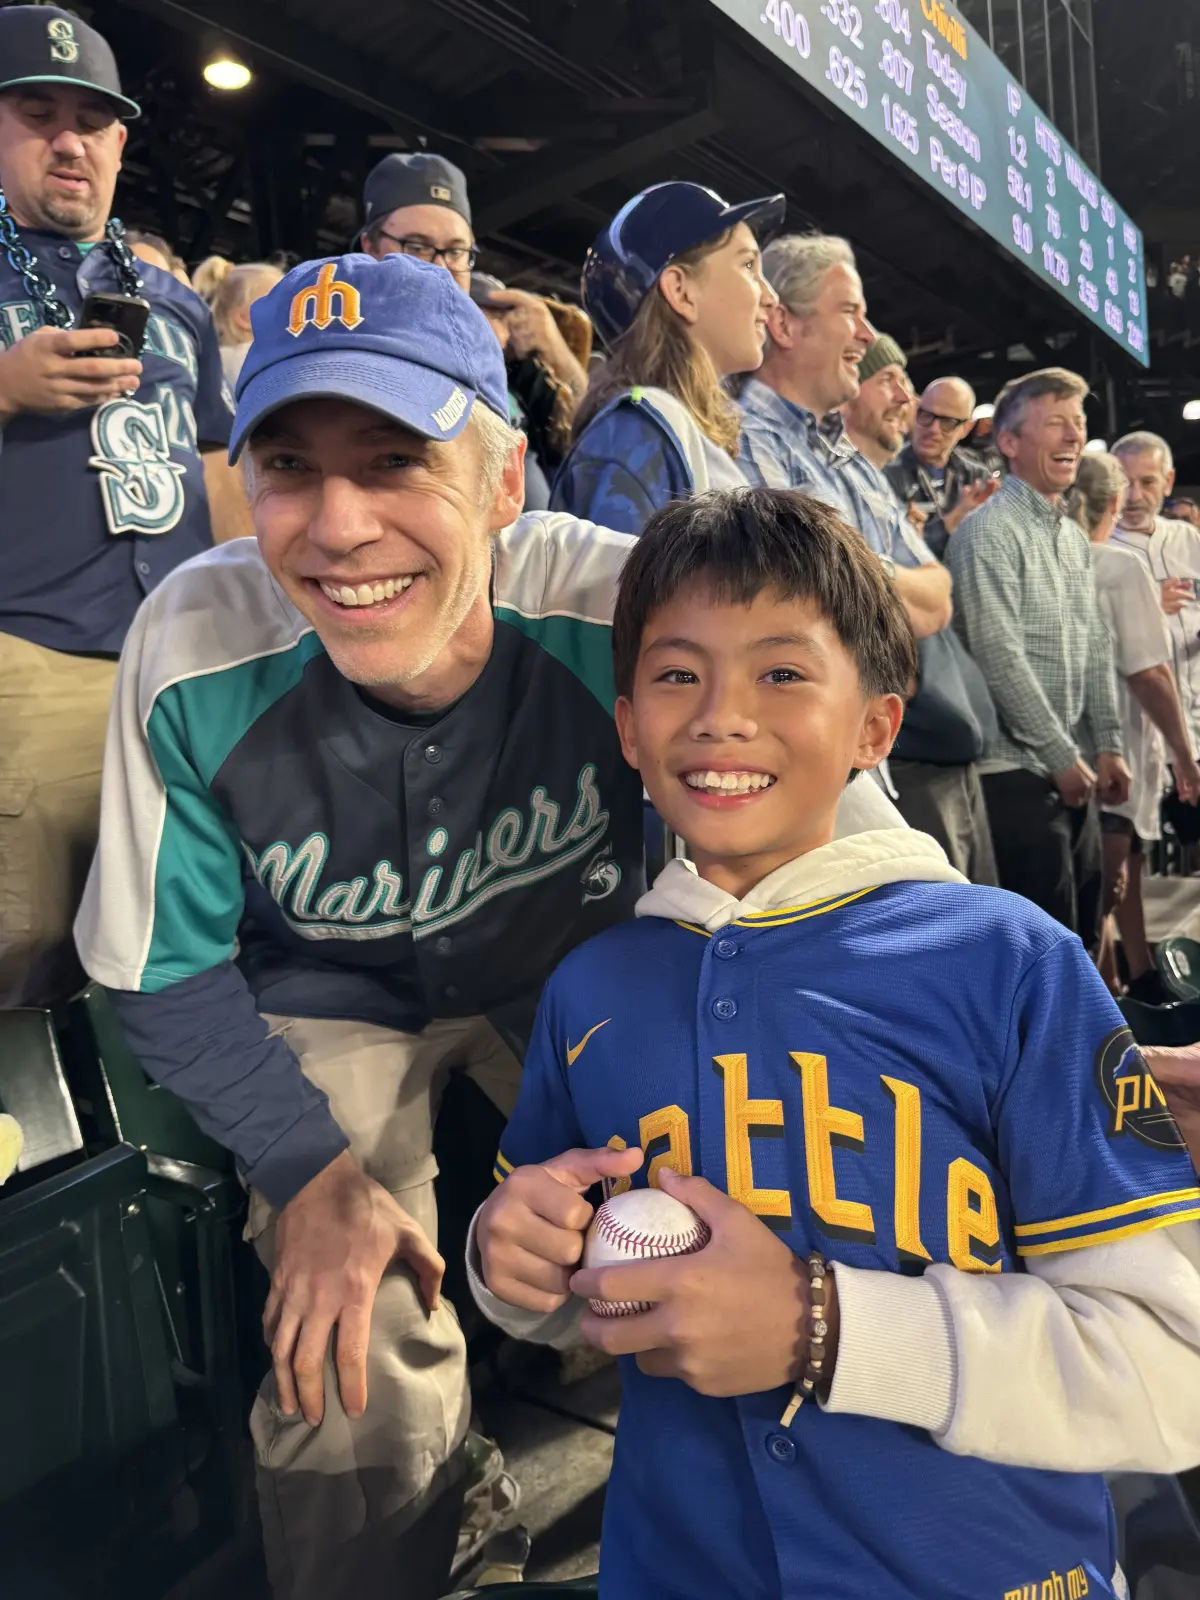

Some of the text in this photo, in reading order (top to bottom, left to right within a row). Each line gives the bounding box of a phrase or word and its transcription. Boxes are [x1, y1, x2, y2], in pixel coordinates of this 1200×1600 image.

[760, 0, 811, 59] .400
[825, 45, 868, 109] .625
[921, 28, 967, 110] Today
[1045, 166, 1057, 197] 3
[926, 83, 981, 163] Season
[929, 135, 957, 189] Per
[957, 163, 971, 199] 9
[240, 762, 610, 942] Mariners
[602, 1051, 1002, 1275] attle
